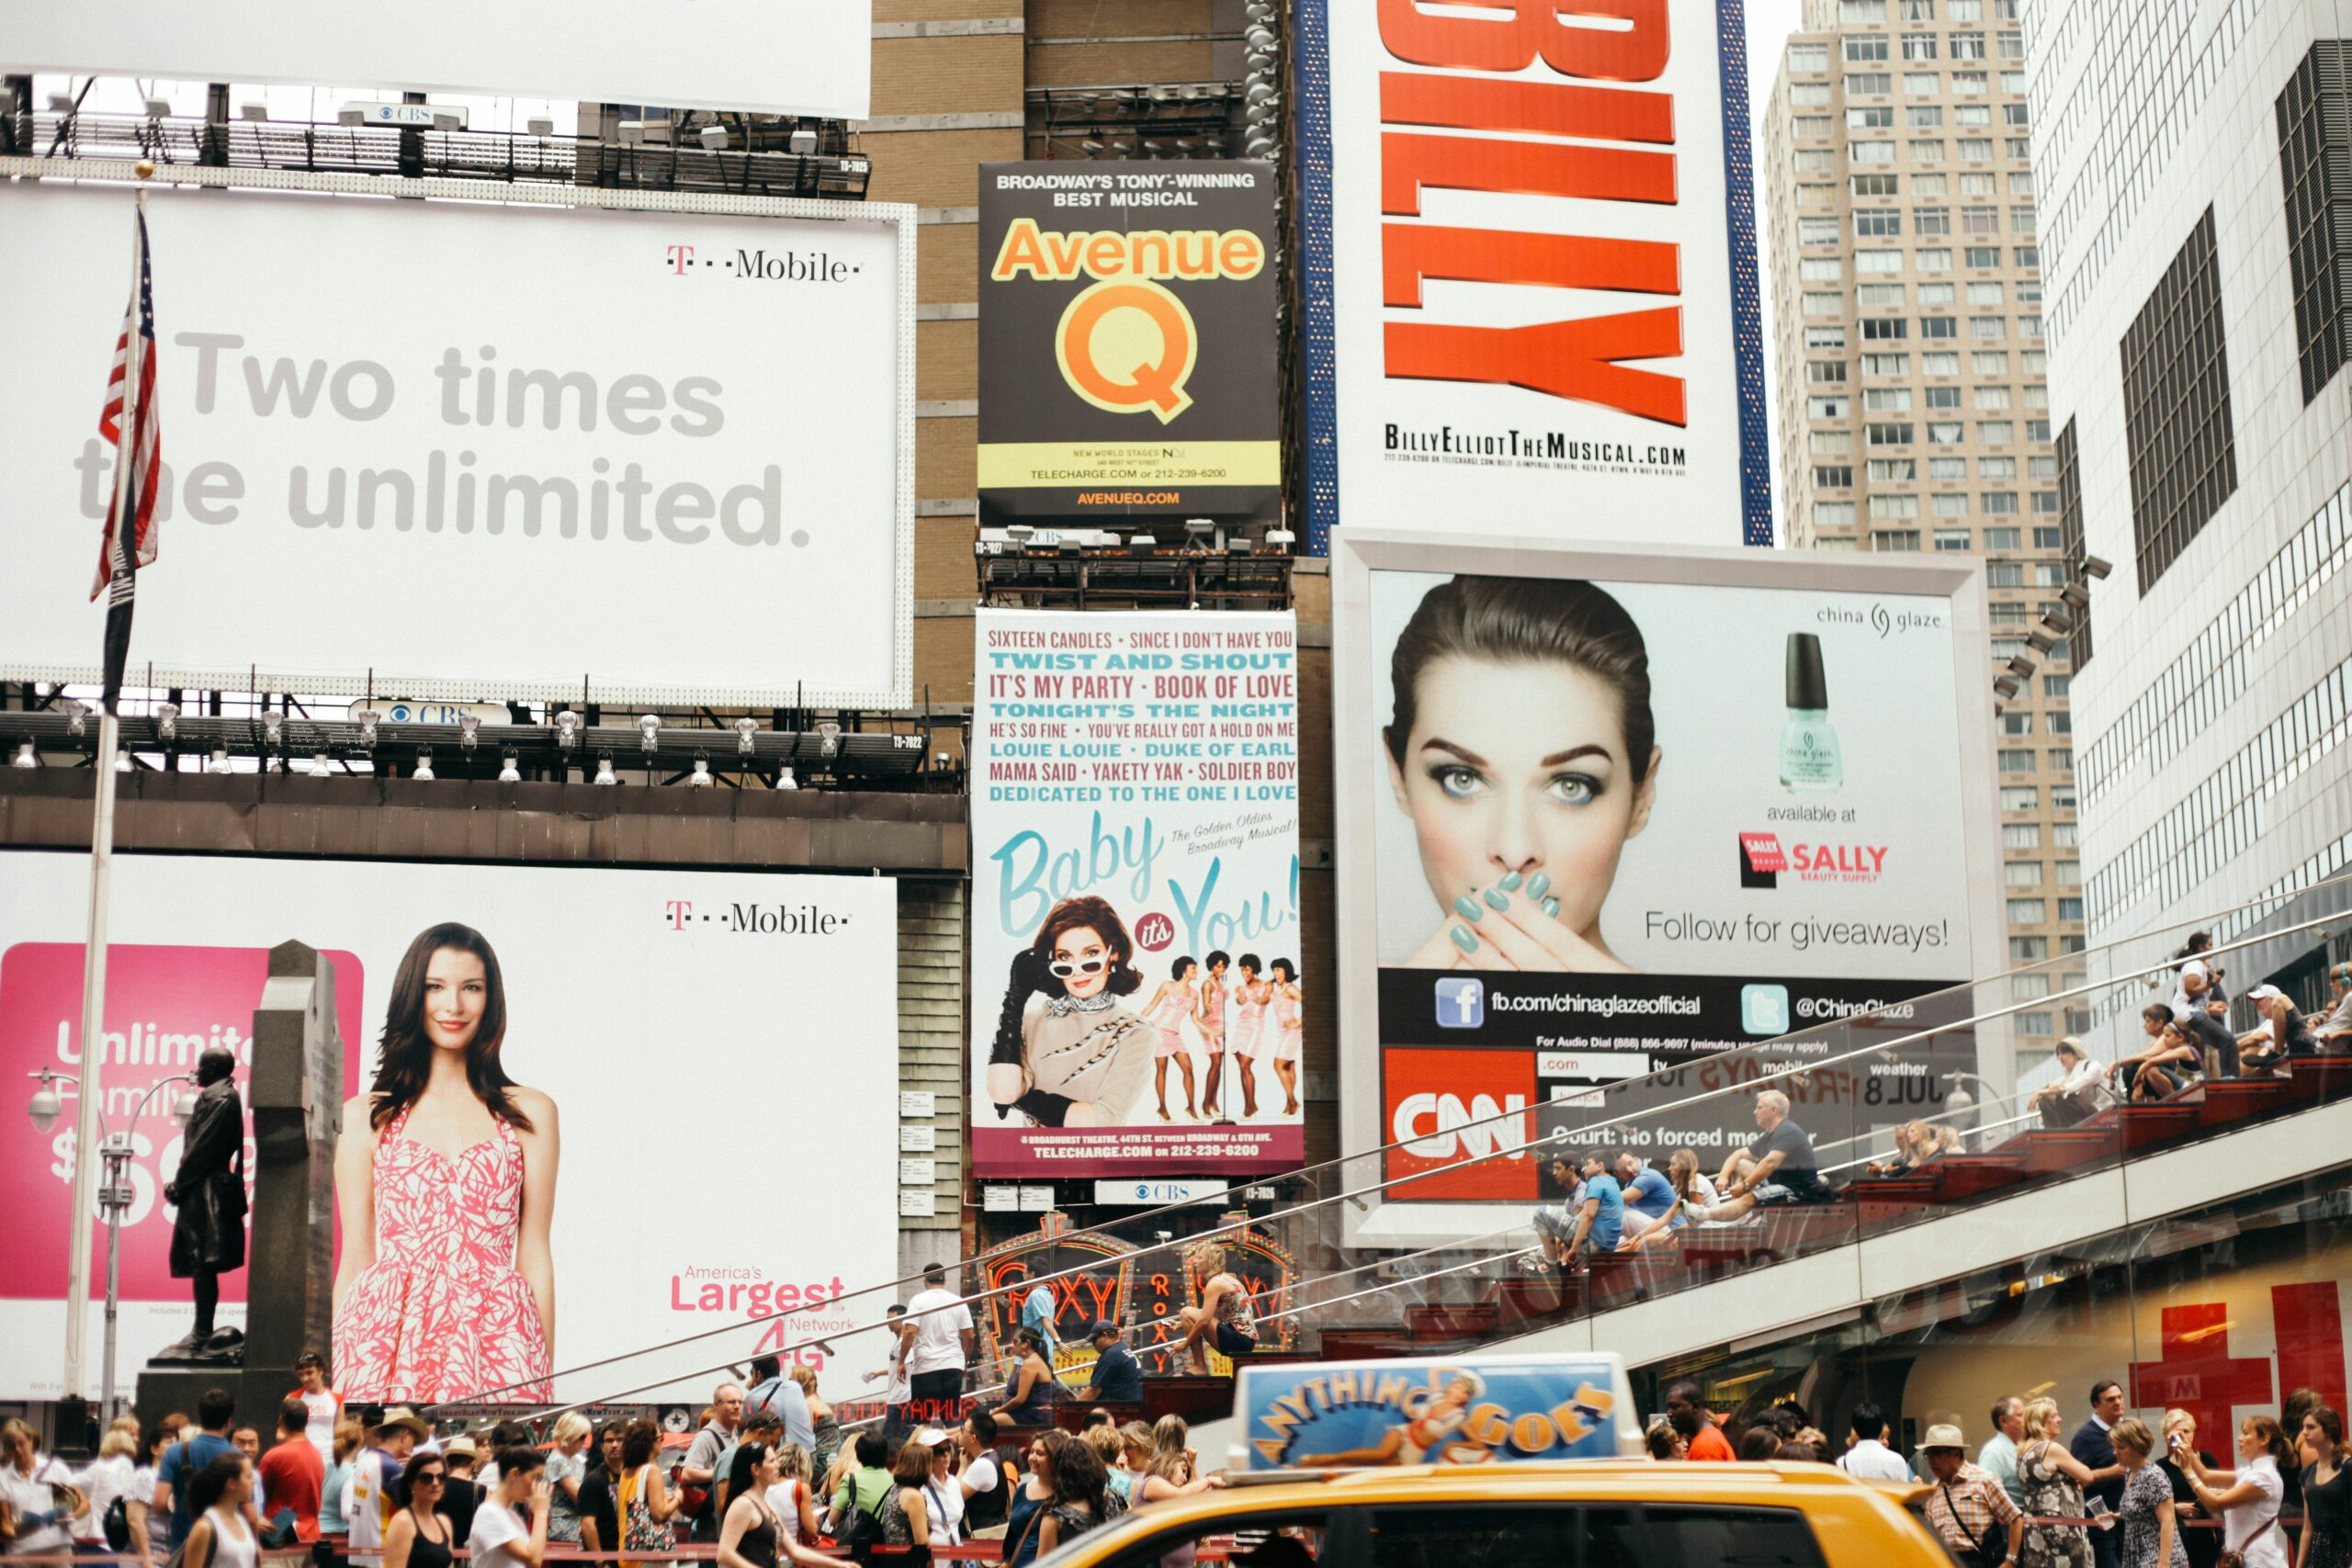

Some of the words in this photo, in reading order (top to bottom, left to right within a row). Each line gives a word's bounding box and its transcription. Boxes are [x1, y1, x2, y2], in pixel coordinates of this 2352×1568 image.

[397, 107, 430, 121] CBS
[997, 175, 1113, 190] BROADWAY'S
[1054, 192, 1102, 207] BEST
[1110, 191, 1198, 207] MUSICAL
[990, 217, 1265, 281] Avenue
[1056, 277, 1198, 425] Q
[175, 332, 395, 423] Two
[435, 344, 726, 438] times
[1073, 449, 1091, 457] NEW
[1094, 449, 1125, 457] WORLD
[1126, 449, 1159, 457] STAGES
[1030, 469, 1137, 479] TELECHARGE.COM
[1155, 469, 1227, 479] 212-239-6200
[288, 448, 811, 548] unlimited.
[1078, 492, 1180, 505] AVENUEQ.COM
[1817, 608, 1863, 624] china
[989, 631, 1046, 647] SIXTEEN
[1051, 632, 1112, 649] CANDLES
[1130, 632, 1170, 649] SINCE
[1175, 632, 1179, 649] I
[1183, 632, 1223, 649] DON'T
[1227, 632, 1261, 649] HAVE
[1265, 631, 1292, 647] YOU
[989, 653, 1098, 670] TWIST
[1105, 653, 1173, 670] AND
[1182, 653, 1293, 670] SHOUT
[989, 675, 1026, 698] IT'S
[1035, 675, 1064, 698] MY
[1072, 676, 1133, 698] PARTY
[1155, 676, 1207, 698] BOOK
[1216, 675, 1238, 698] OF
[1246, 675, 1293, 698] LOVE
[989, 704, 1135, 717] TONIGHT'S
[1147, 704, 1200, 717] THE
[1211, 704, 1295, 717] NIGHT
[989, 723, 1016, 738] HE'S
[1021, 723, 1036, 738] SO
[1041, 724, 1068, 738] FINE
[1088, 724, 1131, 738] YOU'VE
[1135, 724, 1178, 738] REALLY
[1182, 723, 1205, 738] GOT
[1210, 723, 1216, 737] A
[1221, 723, 1253, 738] HOLD
[1257, 723, 1273, 737] ON
[1277, 723, 1295, 737] ME
[989, 744, 1053, 757] LOUIE
[1060, 744, 1122, 757] LOUIE
[1146, 744, 1202, 757] DUKE
[1208, 743, 1236, 757] OF
[1242, 743, 1295, 756] EARL
[989, 763, 1037, 781] MAMA
[1042, 763, 1077, 781] SAID
[1092, 763, 1149, 781] YAKETY
[1154, 763, 1183, 781] YAK
[1198, 762, 1262, 781] SOLDIER
[1267, 762, 1295, 780] BOY
[989, 787, 1102, 802] DEDICATED
[1108, 787, 1135, 801] TO
[1141, 787, 1181, 801] THE
[1187, 786, 1227, 801] ONE
[1234, 786, 1238, 801] I
[1246, 786, 1296, 801] LOVE
[1768, 807, 1837, 822] available
[1841, 807, 1855, 821] at
[1172, 829, 1192, 843] The
[1194, 820, 1233, 839] Golden
[1237, 812, 1273, 827] Oldies
[1187, 834, 1245, 855] Broadway
[1792, 843, 1889, 873] SALLY
[989, 809, 1164, 938] Baby
[1801, 873, 1838, 881] BEAUTY
[1843, 874, 1878, 883] SUPPLY
[1168, 853, 1298, 965] You!
[1141, 917, 1171, 948] it's
[1646, 911, 1736, 942] Follow
[1746, 914, 1781, 942] for
[1792, 916, 1948, 953] giveaways!
[1491, 993, 1700, 1018] fb.com/chinaglazeofficial
[1536, 1036, 1555, 1047] For
[1557, 1037, 1589, 1048] Audio
[1590, 1037, 1611, 1049] Dial
[1871, 1062, 1928, 1077] weather
[1393, 1092, 1526, 1159] CNN
[1552, 1125, 1616, 1145] Court:
[1623, 1127, 1651, 1145] No
[1657, 1127, 1722, 1145] forced
[1034, 1146, 1152, 1158] TELECHARGE.COM
[1170, 1145, 1259, 1156] 212-239-6200
[1154, 1185, 1189, 1201] CBS
[684, 1266, 762, 1280] America's
[672, 1275, 844, 1319] Largest
[790, 1318, 854, 1331] Network
